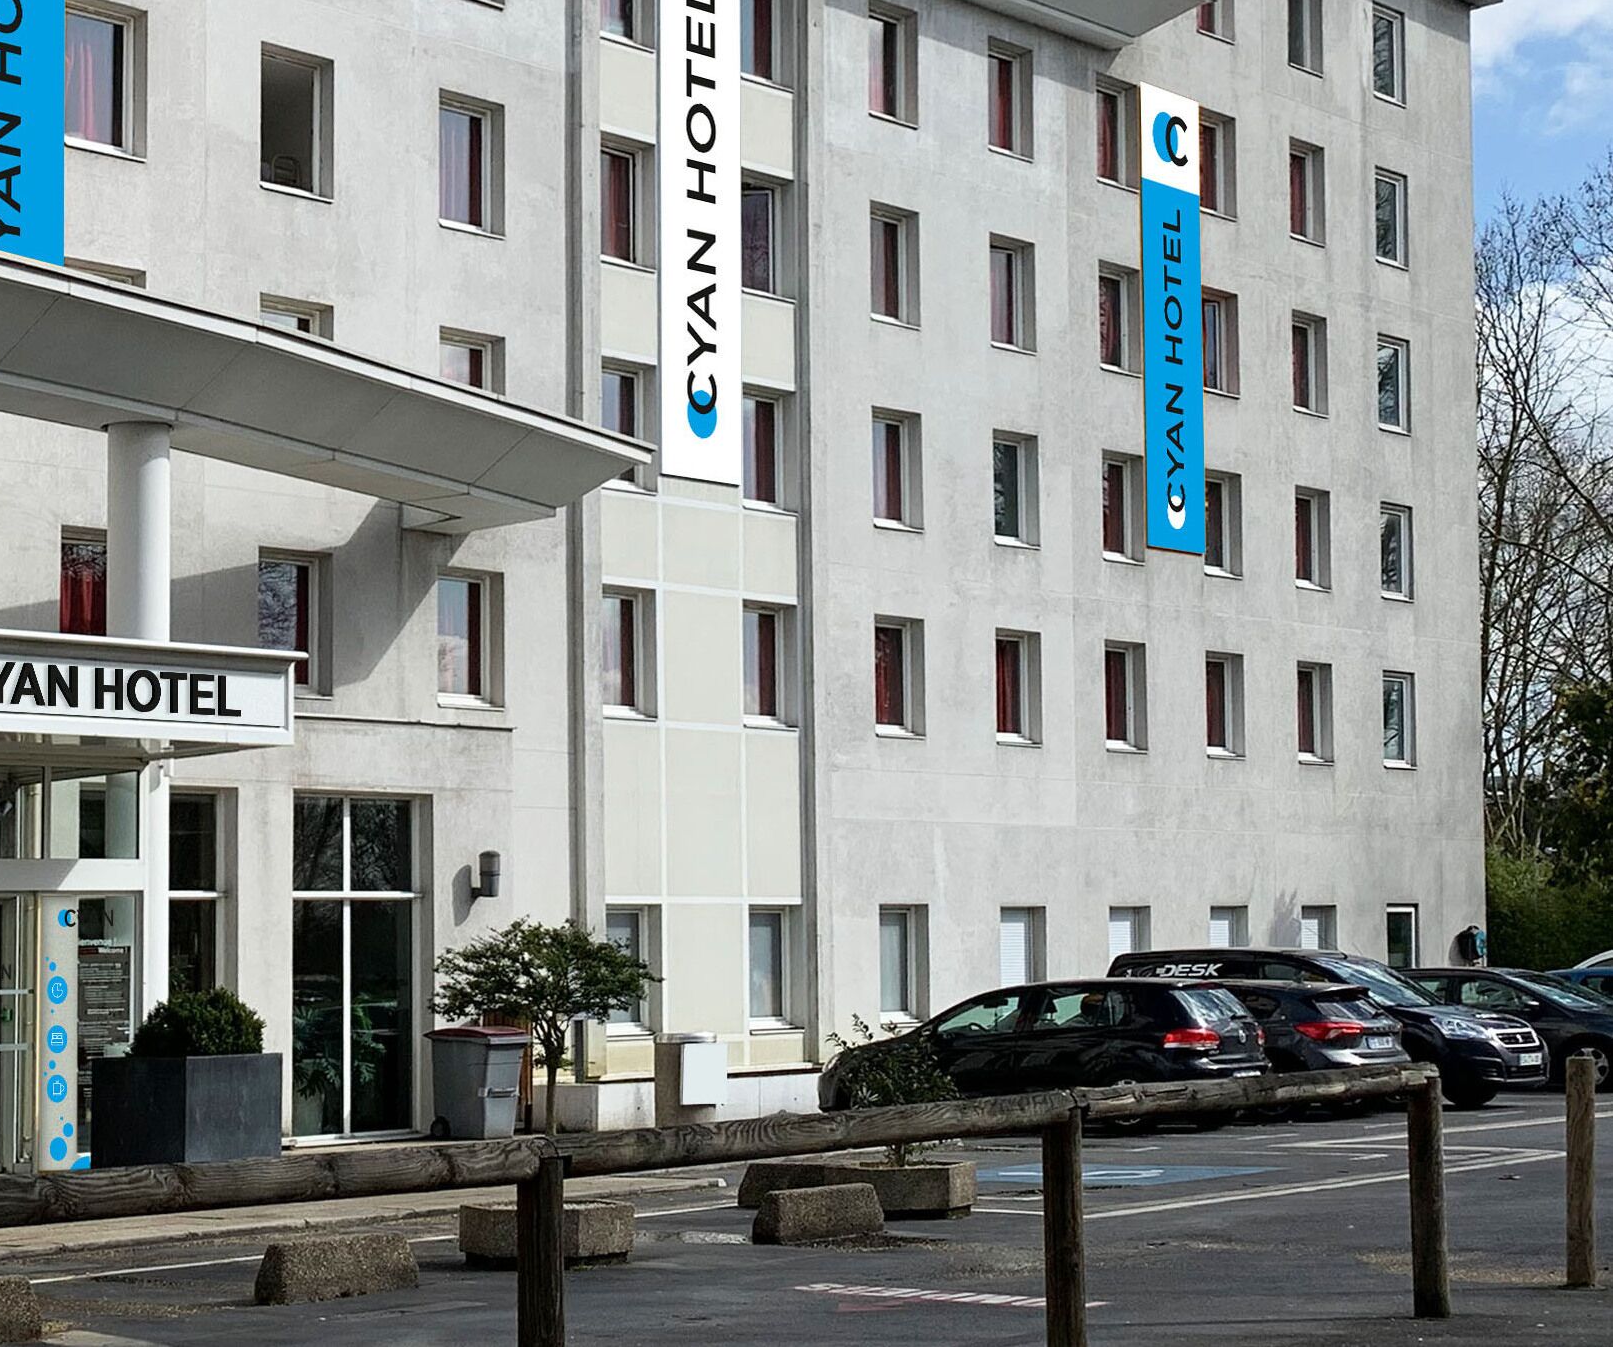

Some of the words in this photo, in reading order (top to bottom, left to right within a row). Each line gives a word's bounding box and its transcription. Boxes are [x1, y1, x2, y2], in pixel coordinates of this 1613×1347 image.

[1165, 116, 1189, 167] C
[686, 229, 717, 415] CYAN
[1163, 209, 1183, 365] HOTEL
[1166, 383, 1186, 513] CYAN
[94, 667, 242, 717] HOTEL
[1156, 963, 1223, 978] DESK
